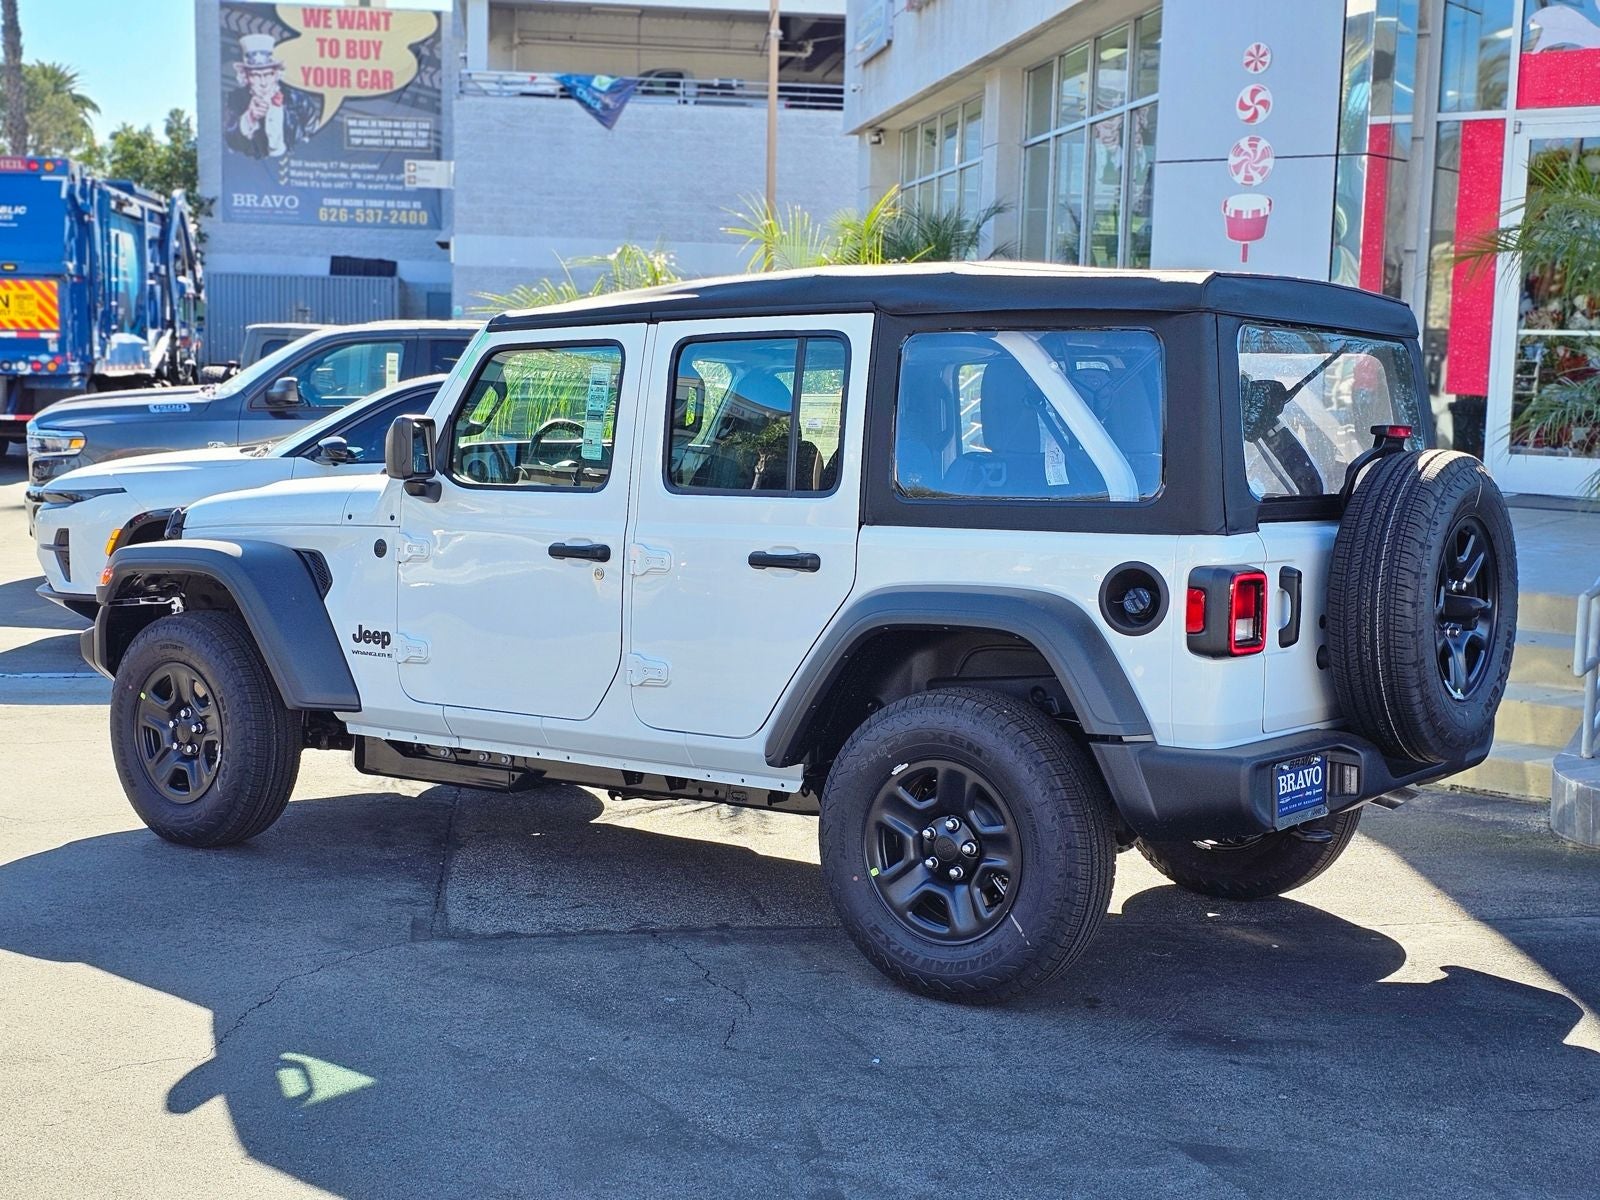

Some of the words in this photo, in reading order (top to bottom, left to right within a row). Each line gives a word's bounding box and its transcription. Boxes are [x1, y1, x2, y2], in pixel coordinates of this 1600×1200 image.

[302, 8, 332, 29] WE
[336, 9, 393, 32] WANT
[316, 37, 340, 59] TO
[345, 39, 383, 61] BUY
[301, 66, 352, 89] YOUR
[356, 68, 394, 90] CAR
[232, 193, 299, 209] BRAVO
[319, 207, 428, 225] 626-537-2400
[352, 624, 391, 649] Jeep
[351, 649, 387, 658] WRANGLER
[1278, 765, 1322, 795] BRAVO
